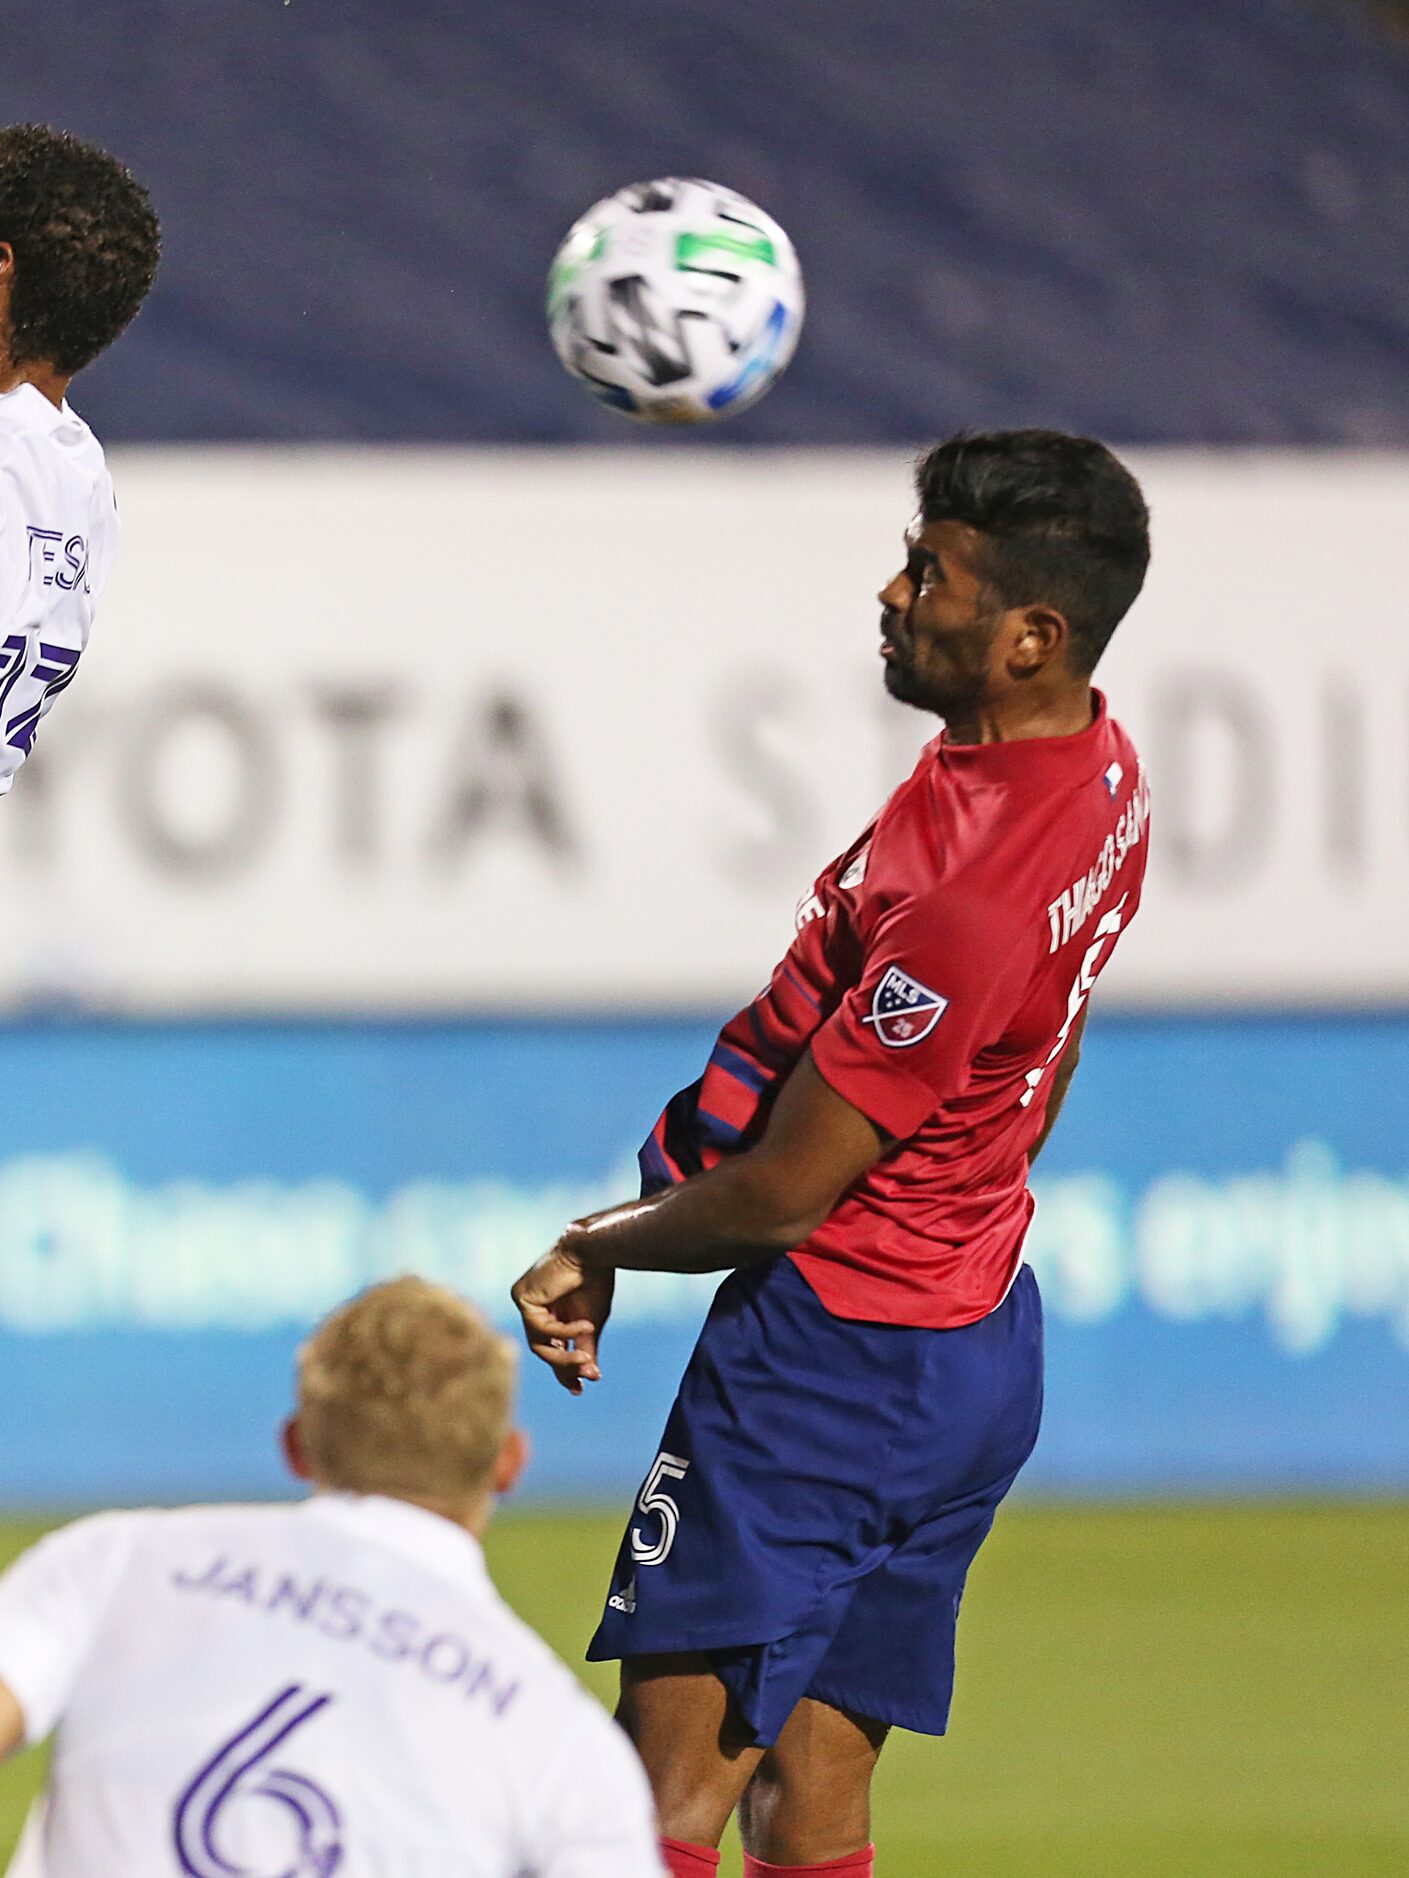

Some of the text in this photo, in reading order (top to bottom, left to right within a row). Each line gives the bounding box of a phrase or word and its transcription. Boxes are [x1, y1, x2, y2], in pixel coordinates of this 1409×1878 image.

[886, 975, 920, 1005] MLS
[631, 1451, 691, 1566] 5
[170, 1555, 522, 1720] JANSSON
[172, 1683, 344, 1878] 6
